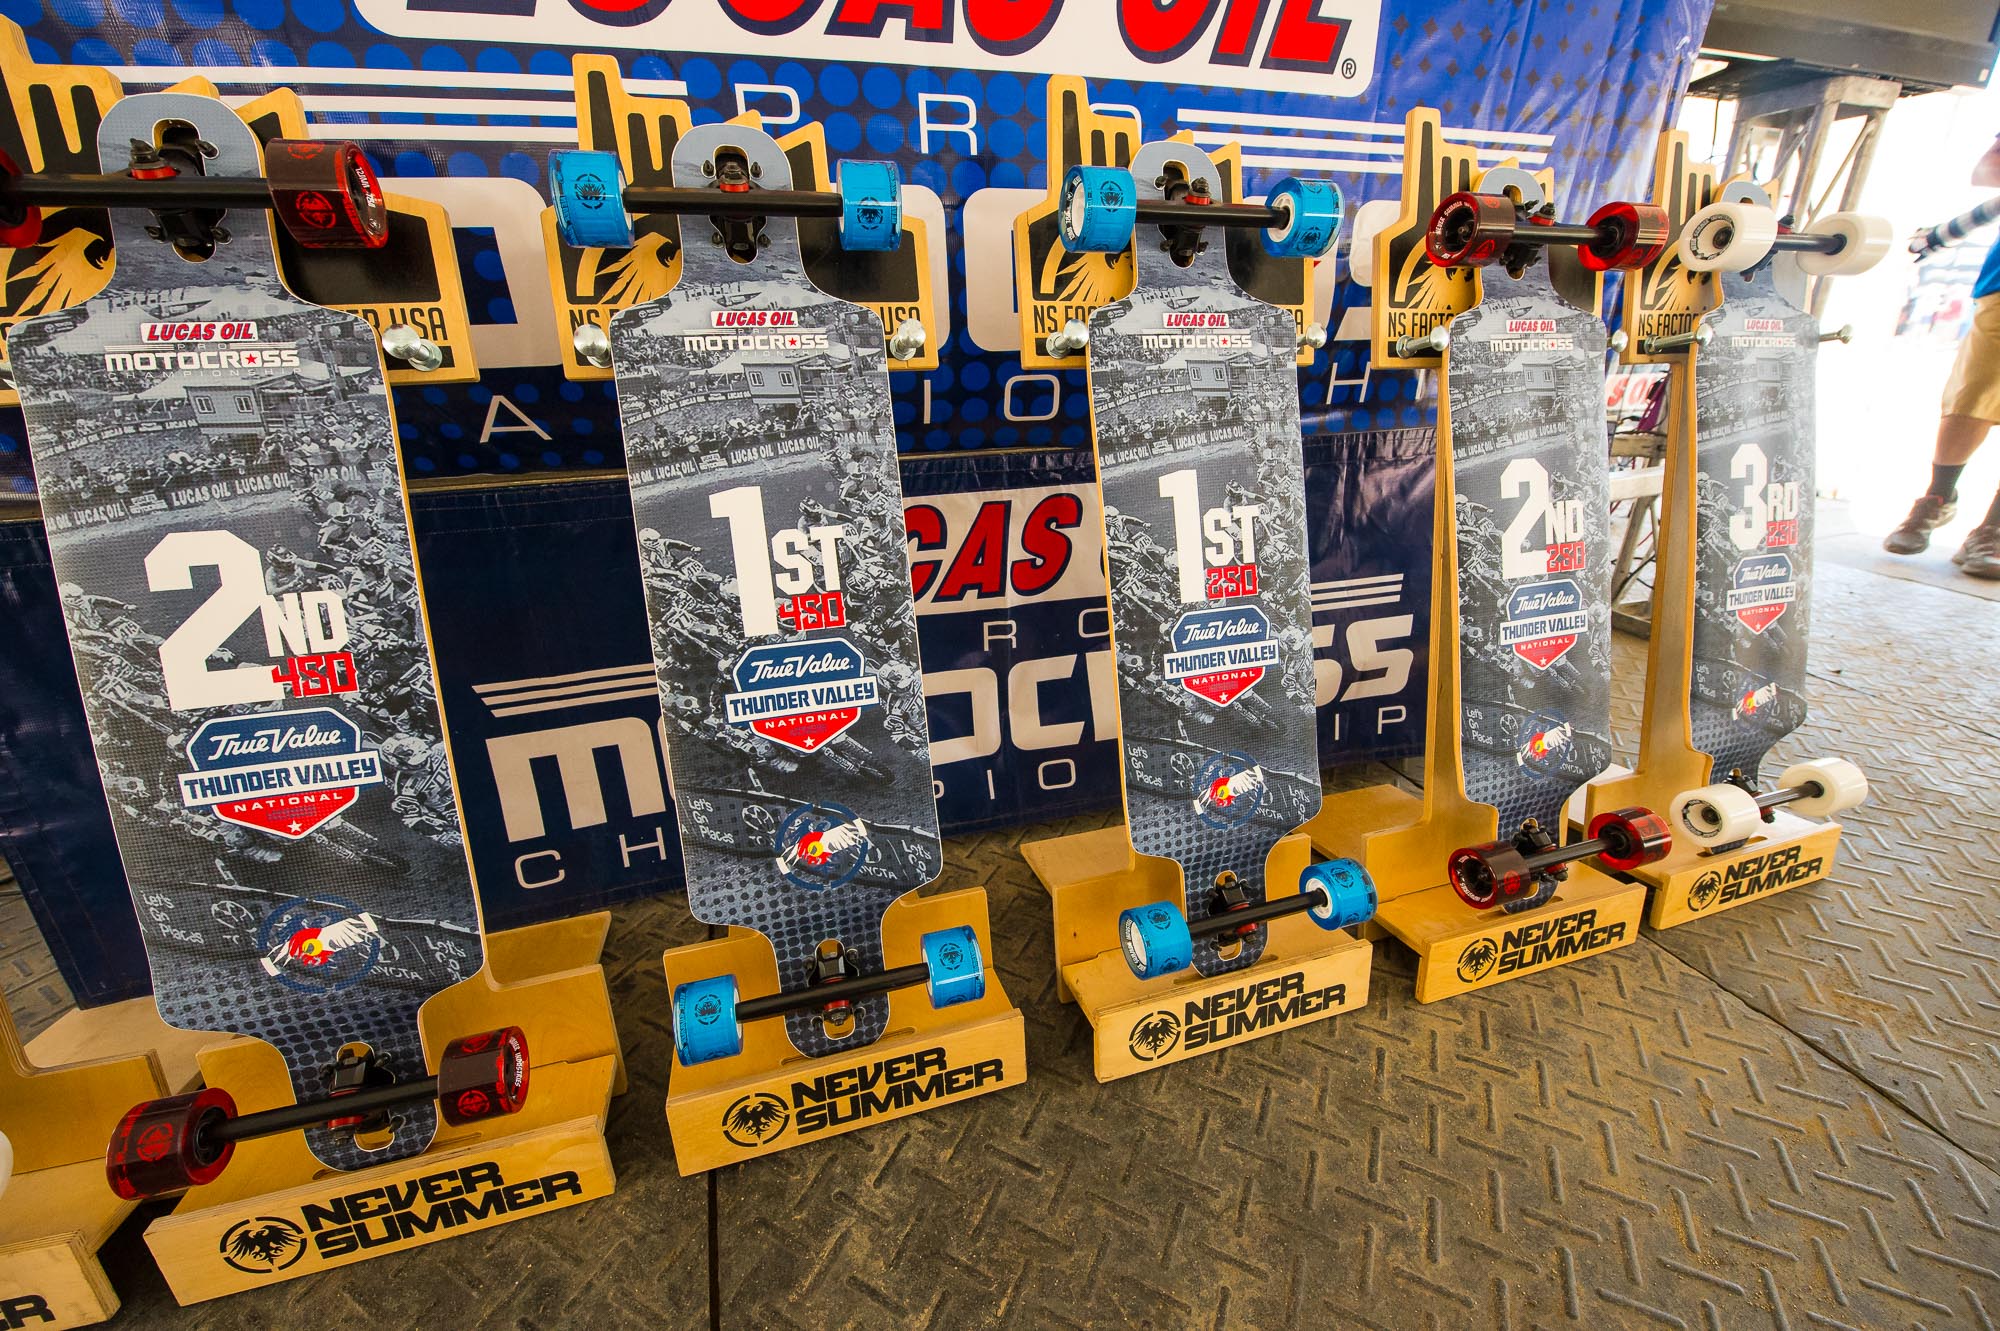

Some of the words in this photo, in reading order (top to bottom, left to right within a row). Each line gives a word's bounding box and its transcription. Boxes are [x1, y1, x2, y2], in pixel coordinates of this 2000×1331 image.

[147, 323, 216, 341] LUCAS
[220, 322, 254, 340] OIL
[716, 311, 767, 326] LUCAS
[770, 311, 796, 325] OIL
[1033, 305, 1058, 333] NS
[1167, 314, 1205, 327] LUCAS
[1208, 313, 1227, 326] OIL
[1388, 312, 1406, 337] NS
[1509, 320, 1538, 332] LUCAS
[1541, 320, 1555, 332] OIL
[1638, 313, 1653, 336] NS
[1746, 320, 1769, 331] LUCAS
[1771, 320, 1783, 331] OIL
[684, 335, 829, 351] MOTOCROSS
[1142, 335, 1252, 349] MOTOCROSS
[1490, 339, 1573, 351] MOTOCROSS
[104, 350, 300, 372] MOTOCROSS
[107, 367, 302, 380] CHAMPIONSHIP
[730, 448, 758, 464] LUCAS
[760, 443, 774, 457] OIL
[777, 438, 806, 454] LUCAS
[806, 436, 820, 449] OIL
[857, 431, 871, 444] OIL
[1175, 437, 1196, 449] LUCAS
[1197, 433, 1208, 447] OIL
[1210, 429, 1232, 442] LUCAS
[341, 466, 361, 481] OIL
[656, 464, 681, 479] LUCAS
[681, 460, 696, 473] OIL
[171, 486, 211, 507] LUCAS
[211, 481, 231, 499] OIL
[235, 475, 272, 494] LUCAS
[273, 473, 291, 488] OIL
[1729, 443, 1799, 551] 3RD
[74, 507, 107, 526] LUCAS
[1500, 458, 1585, 579] 2ND
[1158, 470, 1259, 603] 1ST
[709, 486, 843, 637] 1ST
[1728, 591, 1763, 607] THUNDER
[1765, 584, 1795, 600] VALLEY
[144, 530, 350, 711] 2ND
[779, 592, 846, 631] 450
[1502, 621, 1547, 641] THUNDER
[1549, 613, 1586, 631] VALLEY
[1520, 638, 1570, 650] NATIONAL
[1166, 652, 1226, 674] THUNDER
[1228, 644, 1276, 664] VALLEY
[272, 652, 359, 698] 450
[1192, 670, 1256, 685] NATIONAL
[730, 690, 810, 717] THUNDER
[811, 681, 874, 708] VALLEY
[765, 712, 849, 729] NATIONAL
[1127, 743, 1149, 759] Let's
[184, 767, 295, 800] THUNDER
[294, 757, 376, 788] VALLEY
[233, 792, 343, 812] NATIONAL
[687, 796, 713, 813] Let's
[1725, 845, 1802, 883] NEVER
[1718, 857, 1823, 905] SUMMER
[1501, 909, 1598, 954] NEVER
[1498, 922, 1627, 975] SUMMER
[1185, 971, 1305, 1026] NEVER
[1184, 983, 1346, 1051] SUMMER
[791, 1046, 947, 1108] NEVER
[796, 1058, 1004, 1135] SUMMER
[301, 1161, 506, 1232] NEVER
[312, 1170, 584, 1260] SUMMER
